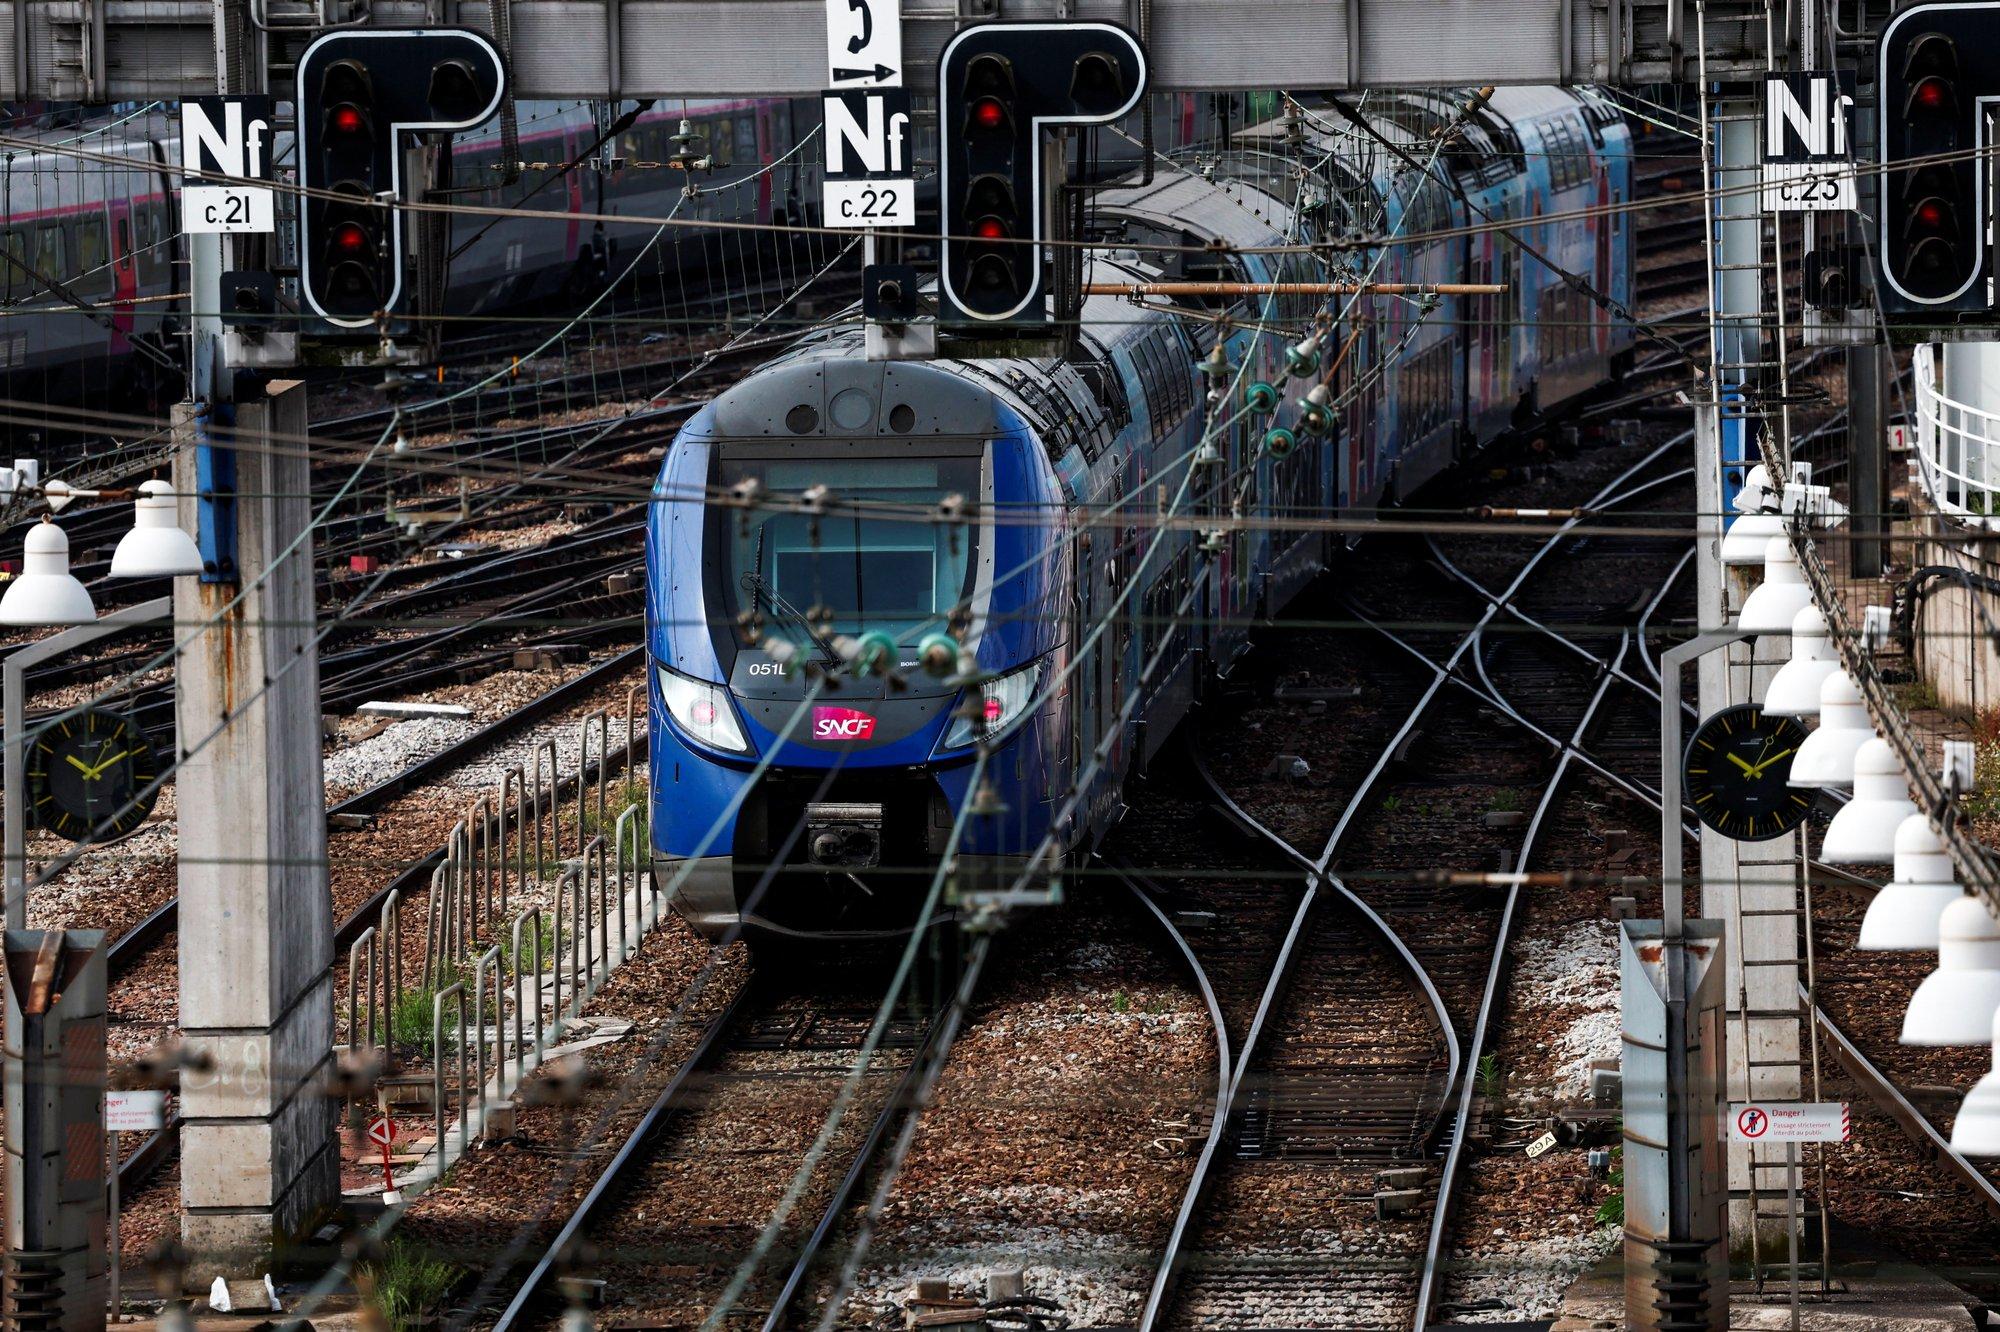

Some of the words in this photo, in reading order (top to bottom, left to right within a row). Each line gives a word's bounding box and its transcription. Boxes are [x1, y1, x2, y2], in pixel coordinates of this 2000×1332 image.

[1767, 78, 1854, 156] Nf
[182, 102, 268, 179] Nf
[824, 96, 909, 172] Nf
[1781, 173, 1839, 201] c.23
[841, 190, 897, 217] c.22
[1895, 429, 1903, 447] 1
[816, 718, 871, 736] SNCF
[1771, 1109, 1801, 1118] Danger
[1773, 1122, 1796, 1130] Passage
